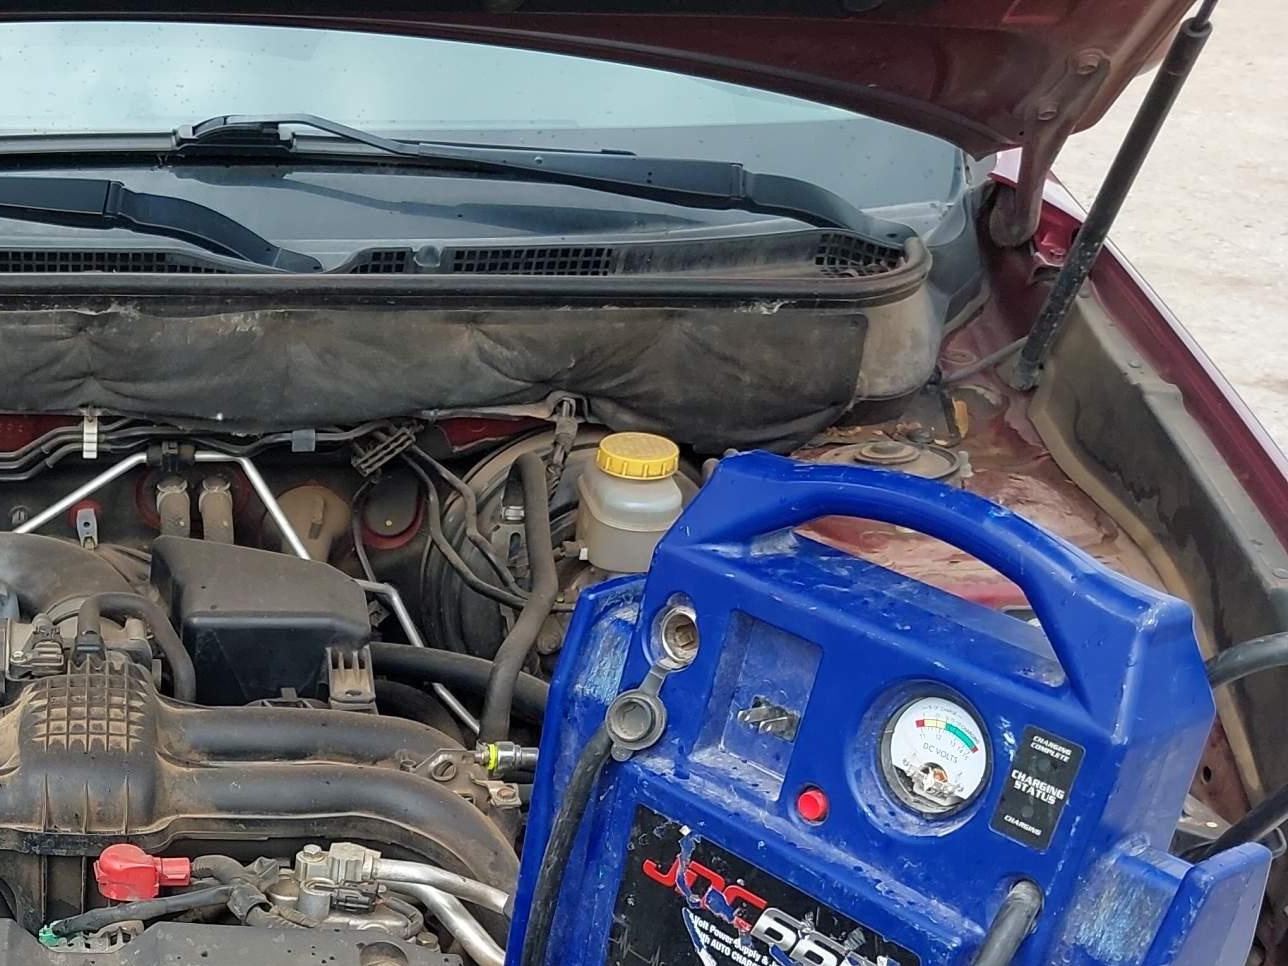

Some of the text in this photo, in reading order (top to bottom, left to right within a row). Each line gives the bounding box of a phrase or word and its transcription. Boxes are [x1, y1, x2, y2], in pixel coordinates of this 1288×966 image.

[922, 742, 959, 764] DC VOLTS
[1030, 742, 1071, 763] COMPLETE
[1032, 735, 1072, 756] CHARGING
[1011, 769, 1065, 800] CHARGING
[1014, 780, 1057, 805] STATUS
[1004, 814, 1042, 836] CHARGING
[709, 924, 734, 945] Power
[762, 955, 769, 966] &
[711, 937, 731, 957] AUTO
